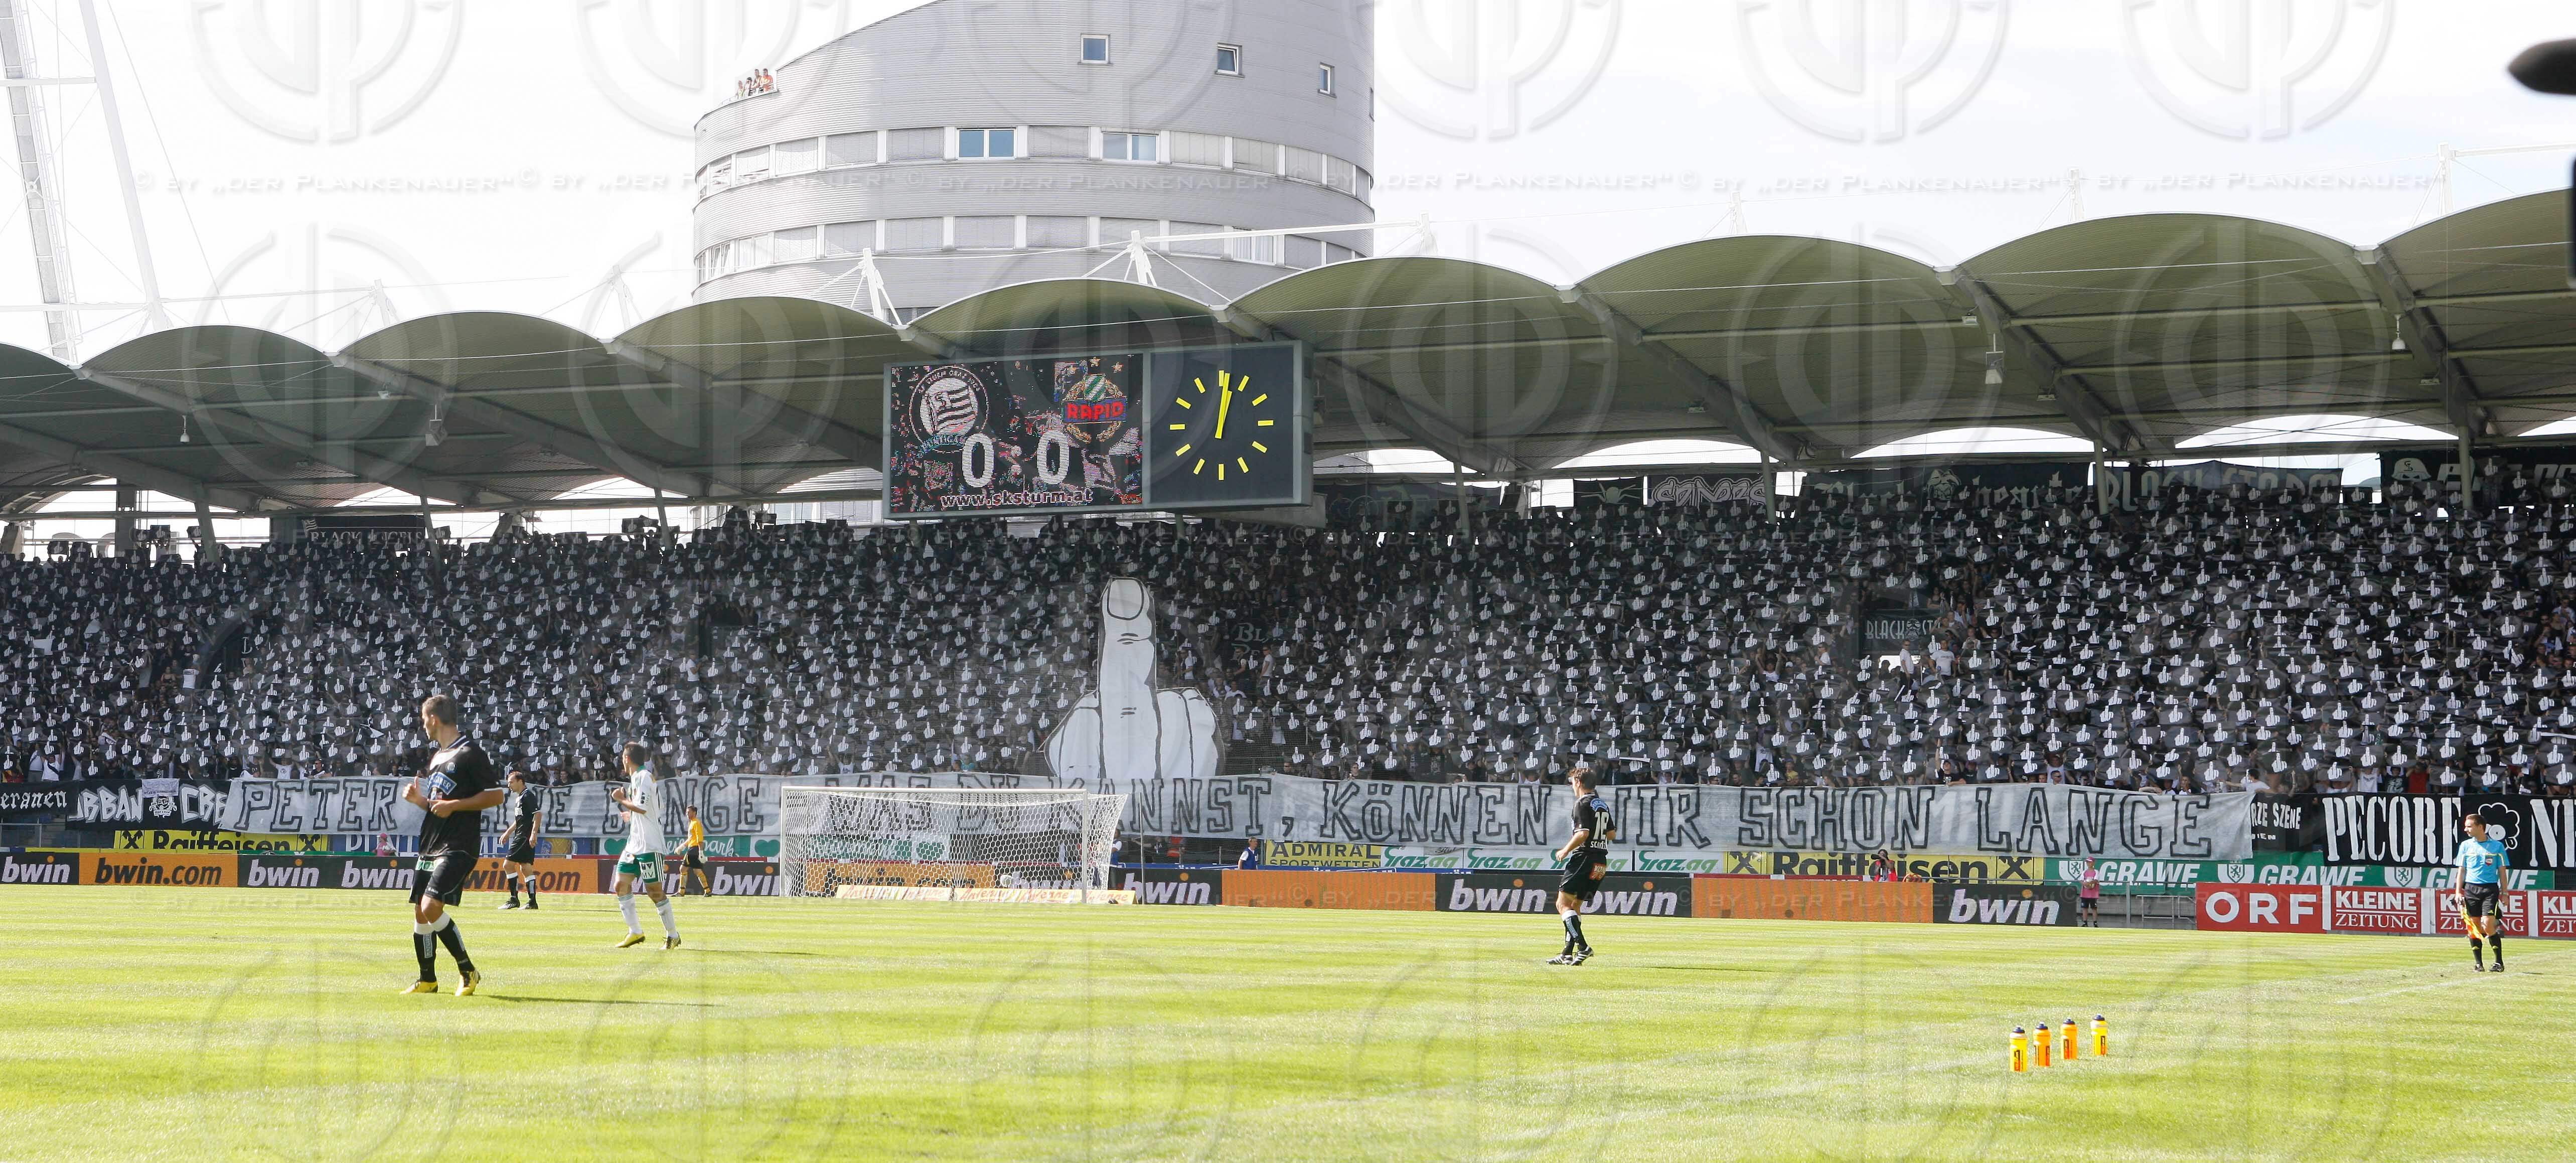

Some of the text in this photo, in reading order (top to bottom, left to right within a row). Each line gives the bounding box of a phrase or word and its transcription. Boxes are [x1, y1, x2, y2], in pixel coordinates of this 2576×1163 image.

[1067, 401, 1125, 420] RAPID
[962, 433, 994, 489] 0
[1037, 431, 1070, 485] 0
[941, 489, 1093, 508] www.sksturm.at
[1865, 620, 1905, 640] BLACK
[234, 780, 399, 832] PETER
[1321, 781, 1552, 846] KÖNNEN
[1739, 786, 1935, 851] SCHON
[1977, 787, 2211, 857] LANGE
[2250, 802, 2302, 829] RZE SZENE
[2322, 796, 2461, 865] PECORE
[1271, 843, 1382, 859] ADMIRAL
[2, 855, 70, 884] bwin
[94, 856, 222, 885] bwin.com
[247, 858, 320, 888] bwin
[2099, 861, 2200, 883] GRAWE
[2258, 865, 2366, 887] GRAWE
[1121, 873, 1210, 904] bwin
[1449, 879, 1546, 912] bwin
[2335, 891, 2417, 911] KLEINE
[1948, 888, 2060, 925] bwin
[2205, 892, 2314, 925] ORF
[2335, 913, 2417, 930] ZEITUNG
